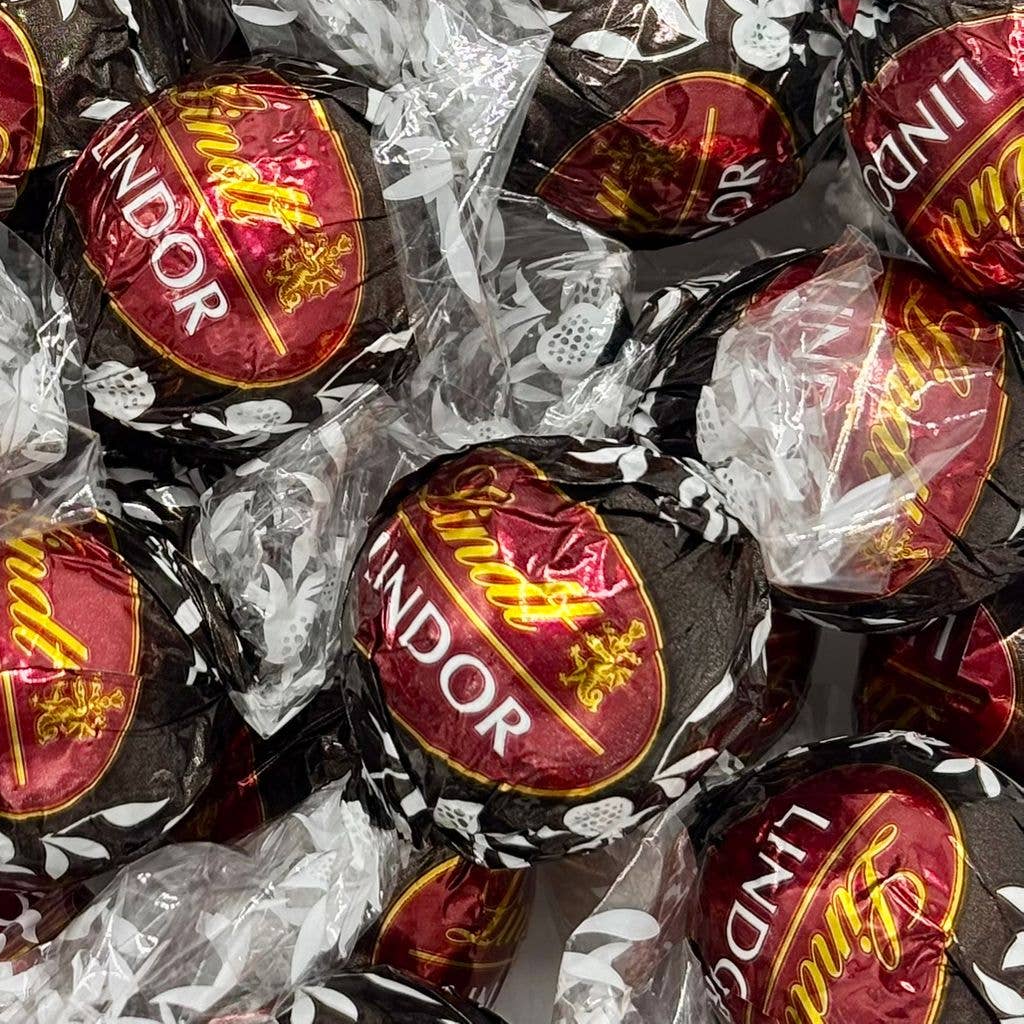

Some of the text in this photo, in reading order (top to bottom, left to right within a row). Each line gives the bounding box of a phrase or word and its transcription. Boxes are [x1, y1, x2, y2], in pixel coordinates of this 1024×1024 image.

[169, 76, 321, 235] Lindt
[862, 57, 996, 213] LINDO
[91, 118, 231, 337] LINDOR
[420, 465, 605, 632] Lindt
[364, 531, 532, 757] LINDOR
